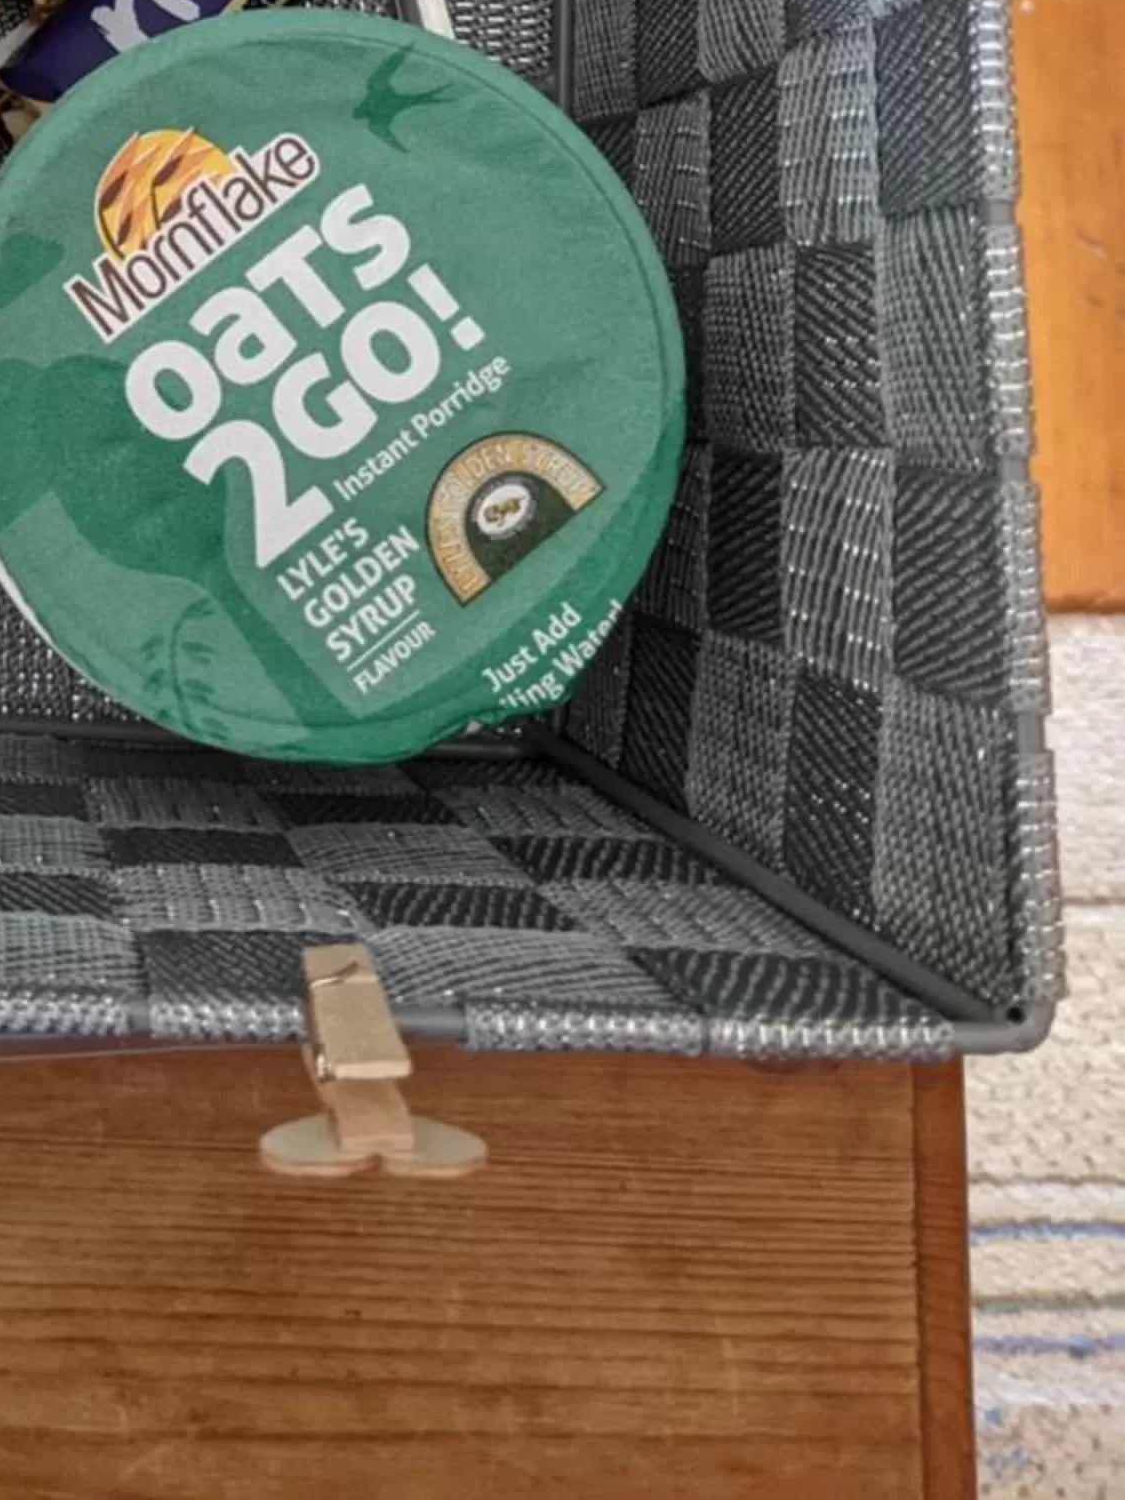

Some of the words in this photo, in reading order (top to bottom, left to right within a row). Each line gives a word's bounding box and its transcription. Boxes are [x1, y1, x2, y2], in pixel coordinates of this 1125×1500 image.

[69, 135, 317, 339] Mornflake
[184, 264, 486, 569] 2GO!
[333, 429, 419, 501] Instant
[411, 353, 512, 438] Porridge
[276, 517, 369, 600] LYLE'S
[304, 525, 420, 628] GOLDEN
[326, 574, 417, 661] SYRUP
[352, 621, 436, 695] FLAVOUR
[481, 646, 539, 693] Just
[532, 601, 583, 655] Add
